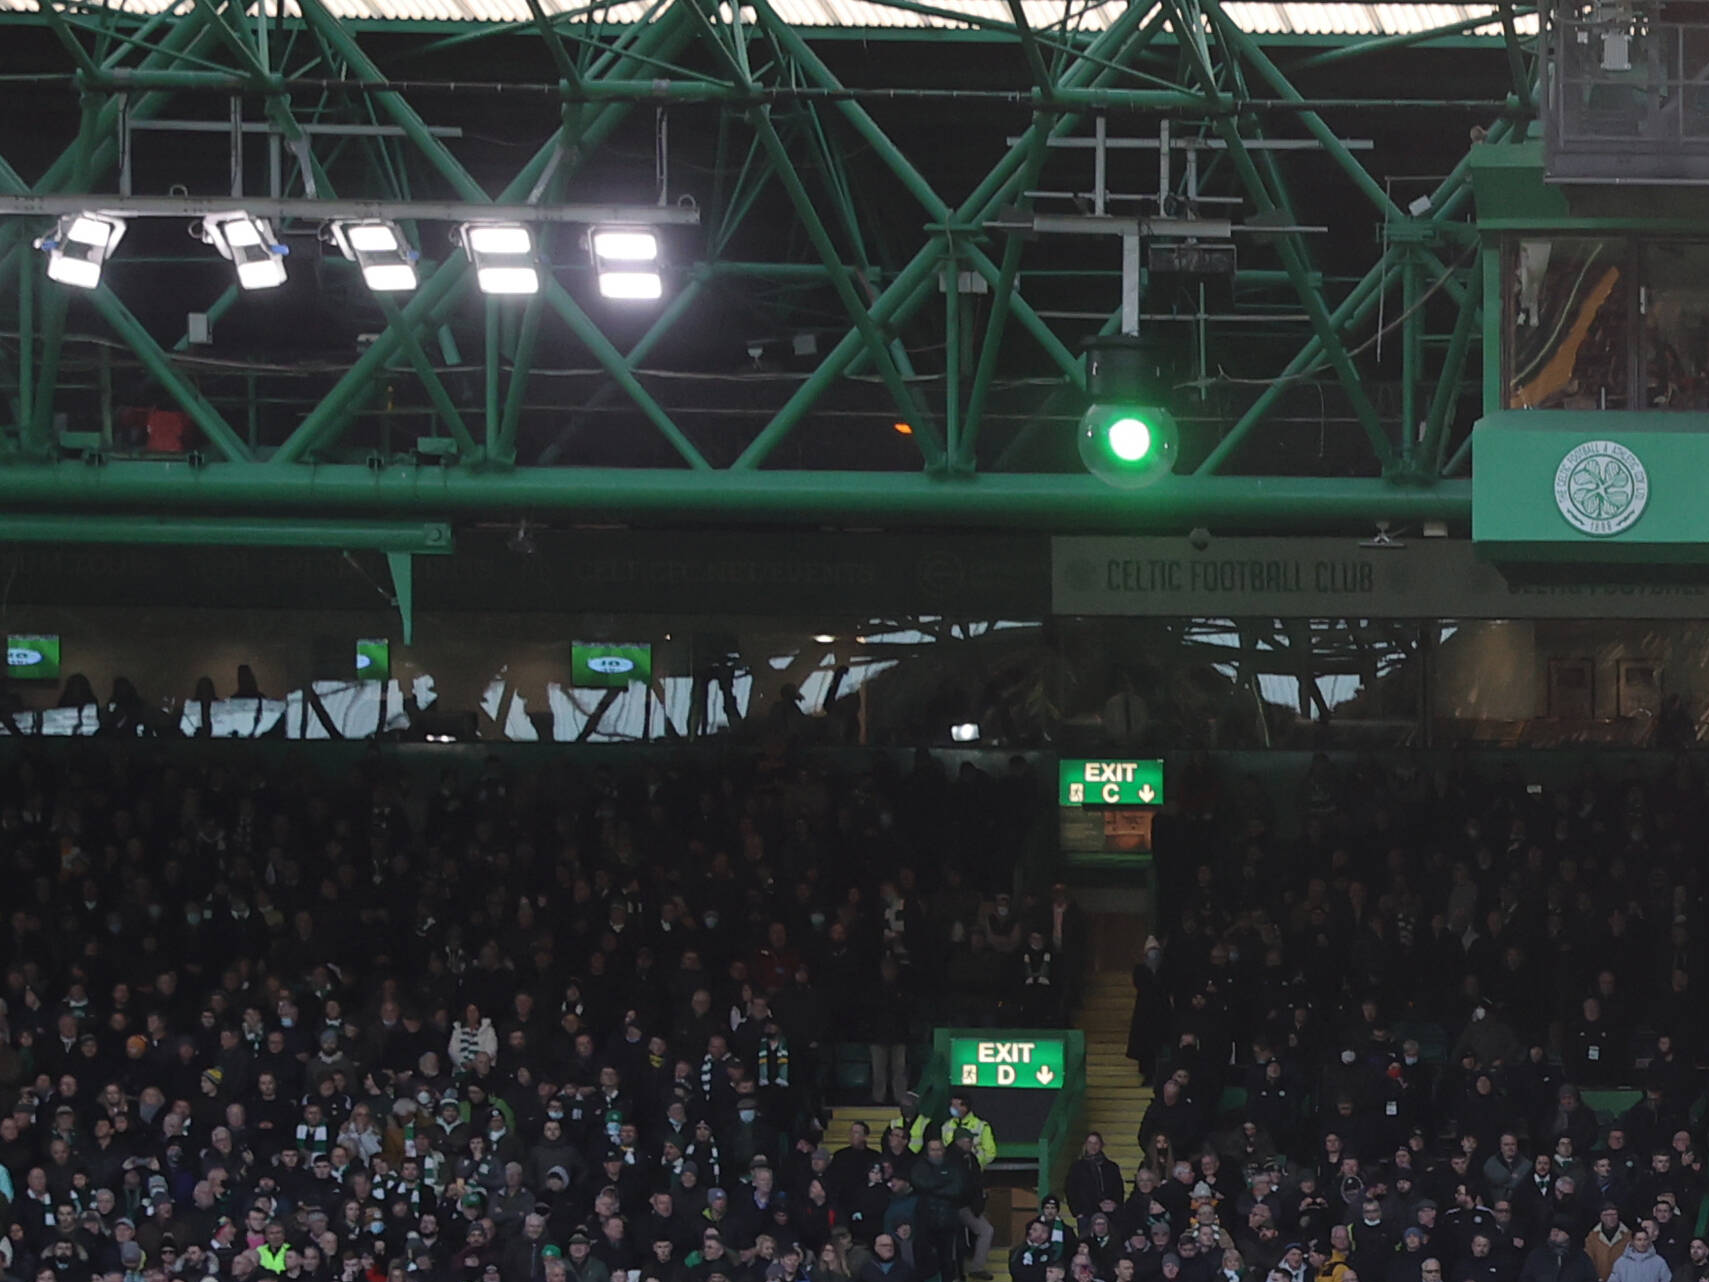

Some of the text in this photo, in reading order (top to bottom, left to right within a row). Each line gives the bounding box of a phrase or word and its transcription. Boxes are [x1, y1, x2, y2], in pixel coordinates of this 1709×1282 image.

[1106, 559, 1374, 591] CELTIC FOOTBALL CLUB
[1085, 763, 1138, 782] EXIT
[1102, 783, 1120, 803] C
[978, 1042, 1035, 1063] EXIT
[997, 1065, 1016, 1085] D
